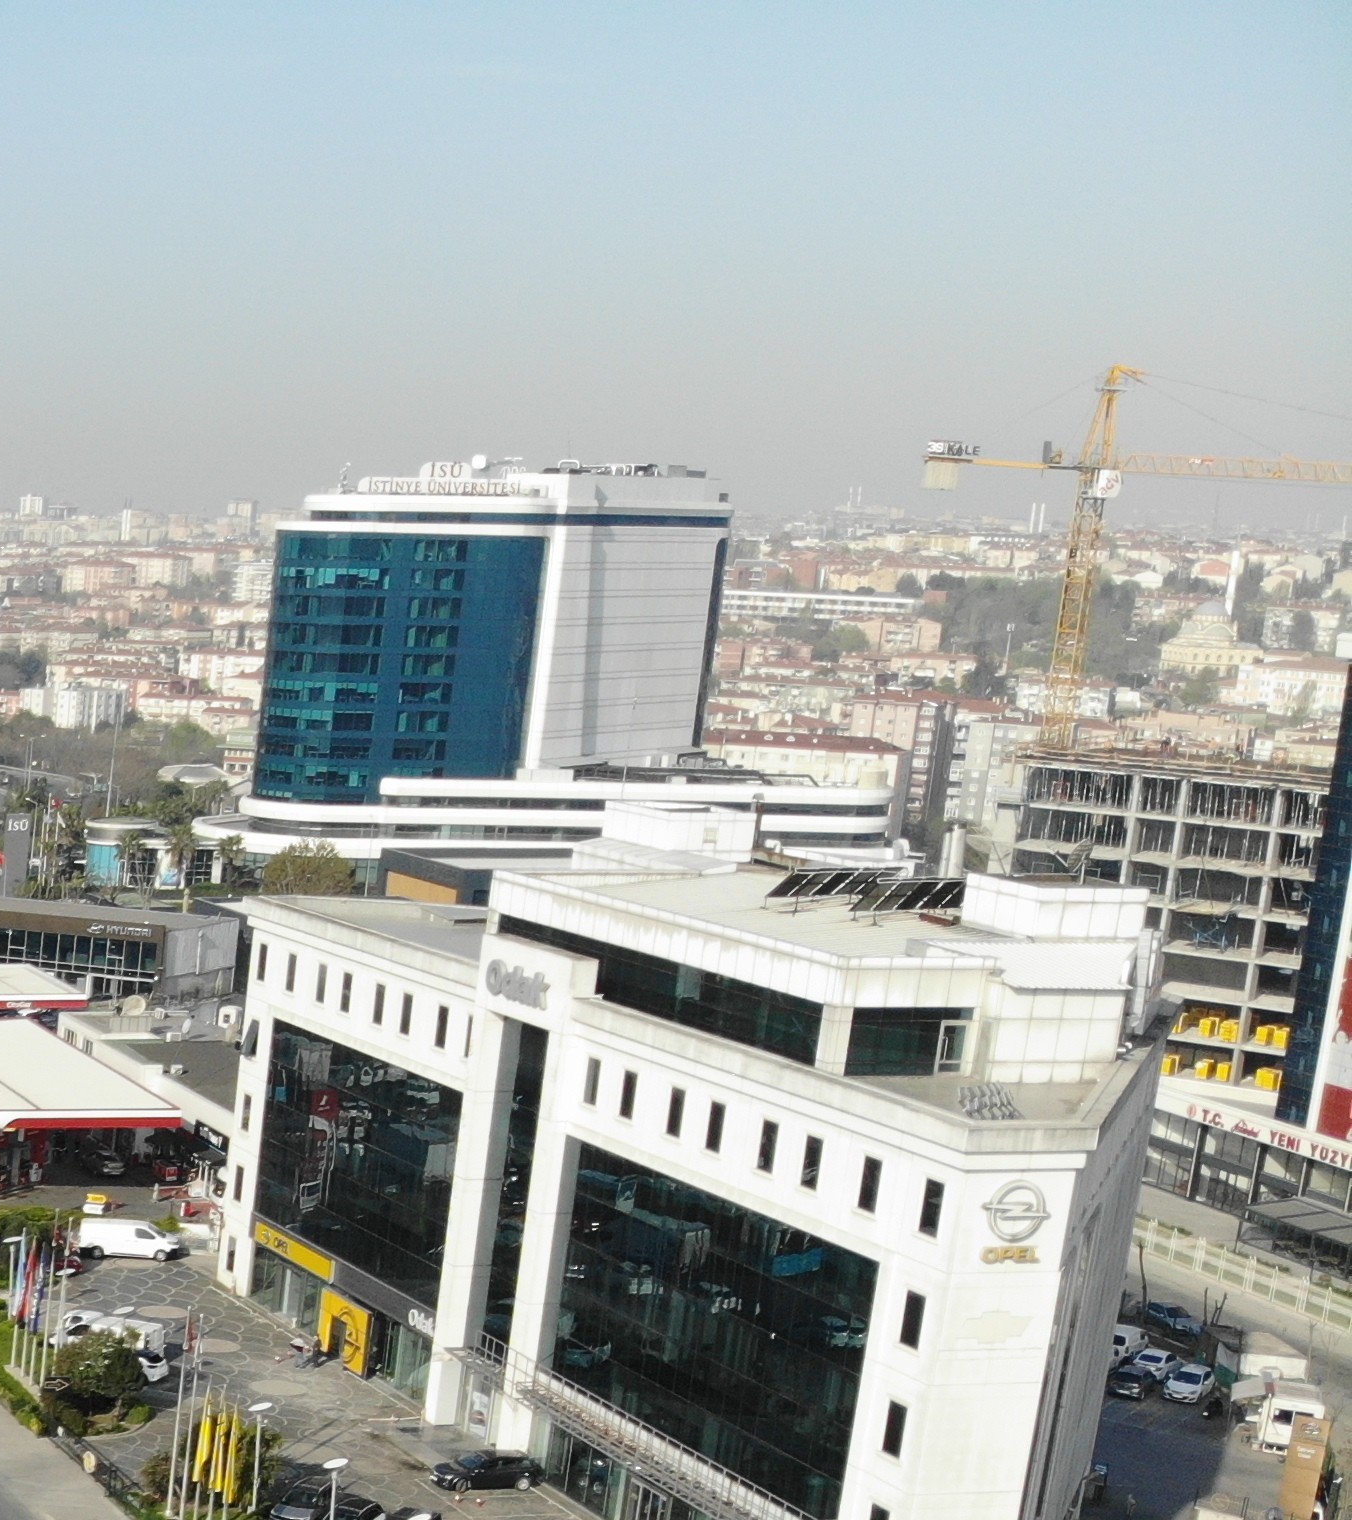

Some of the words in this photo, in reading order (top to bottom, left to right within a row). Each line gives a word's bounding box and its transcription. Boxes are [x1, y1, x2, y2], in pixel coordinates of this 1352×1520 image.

[429, 462, 464, 478] İSÜ
[368, 478, 422, 494] İSTİNYE
[427, 479, 522, 495] ÜNİVERSİTESİ
[7, 818, 29, 831] İSÜ
[106, 925, 152, 938] HYUNDAI
[1202, 1109, 1225, 1129] T.C.
[273, 1236, 289, 1255] OPEL
[978, 1245, 1042, 1265] OPEL
